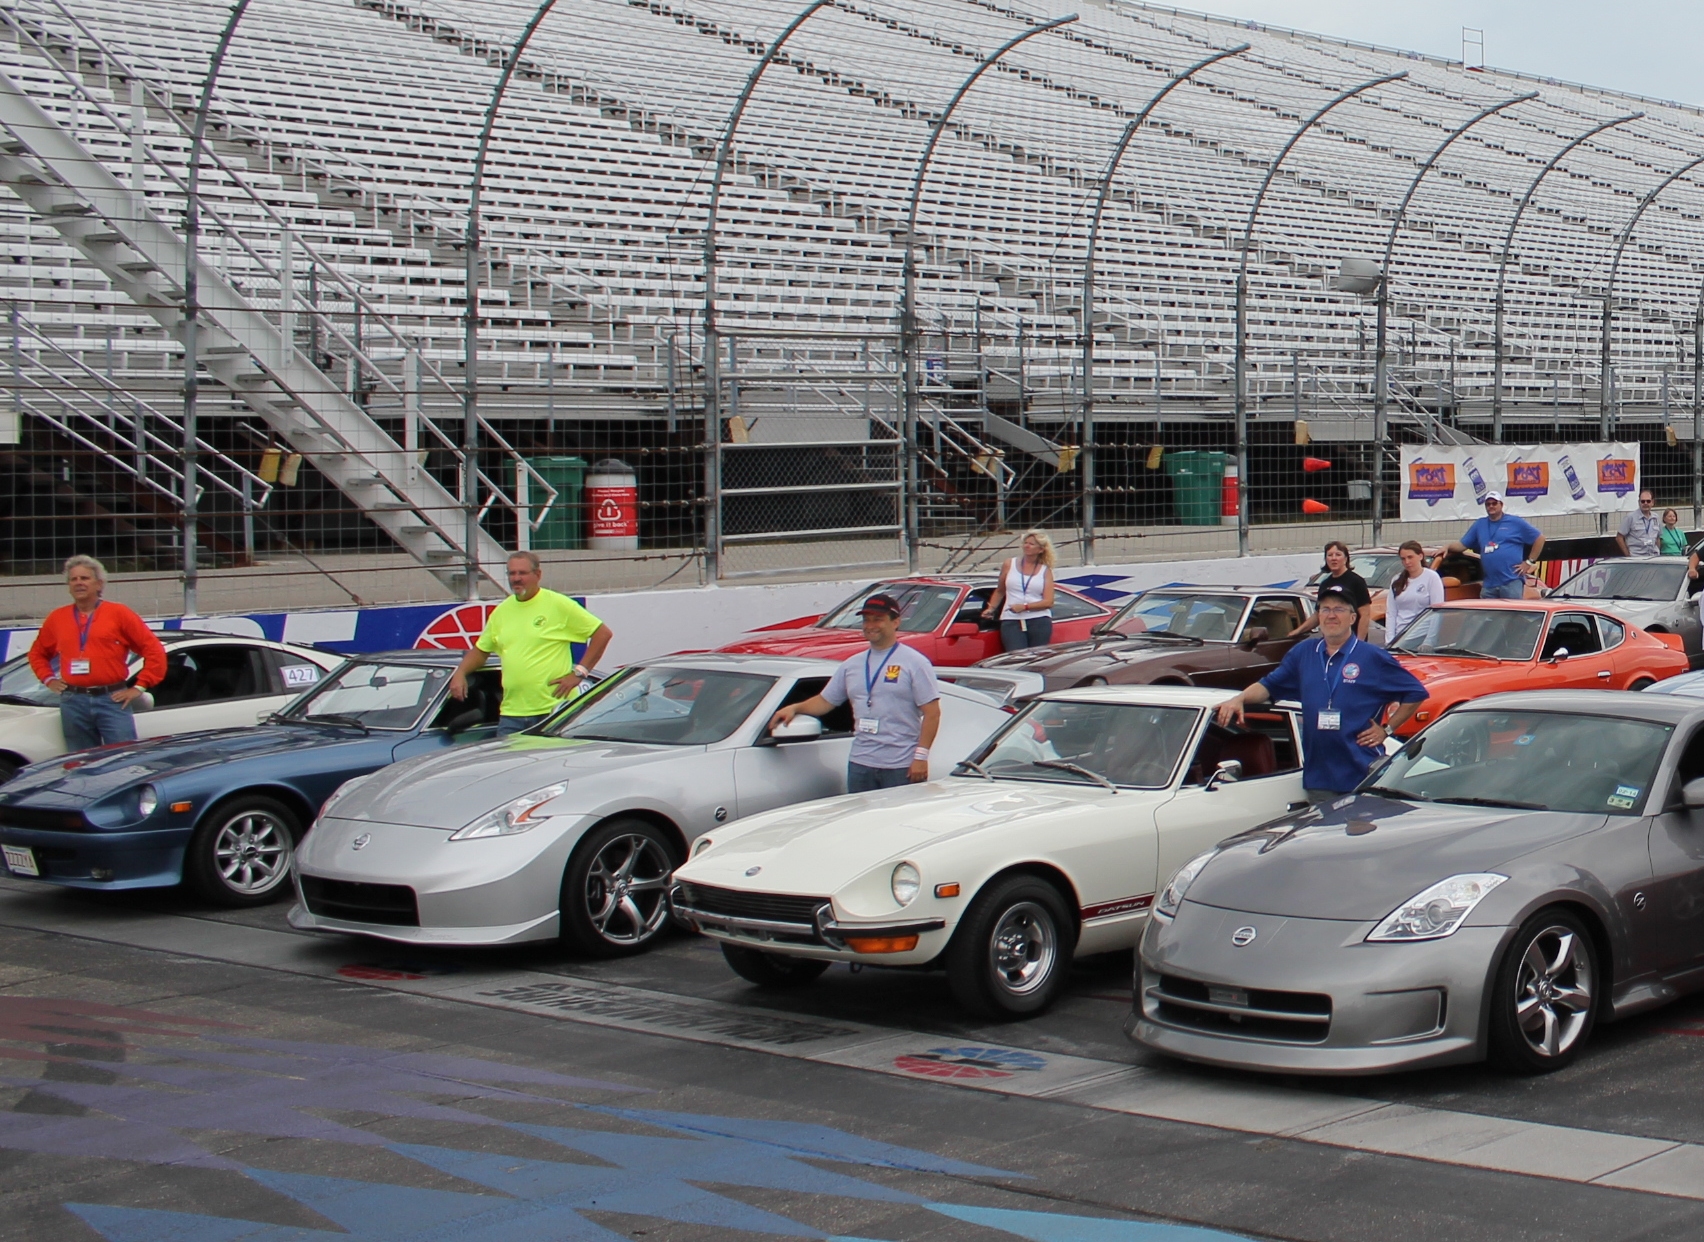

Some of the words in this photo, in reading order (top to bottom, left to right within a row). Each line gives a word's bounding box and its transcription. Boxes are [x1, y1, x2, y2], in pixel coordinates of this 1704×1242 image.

[612, 520, 628, 528] back
[288, 668, 314, 682] 427
[1097, 900, 1146, 915] DATSUN
